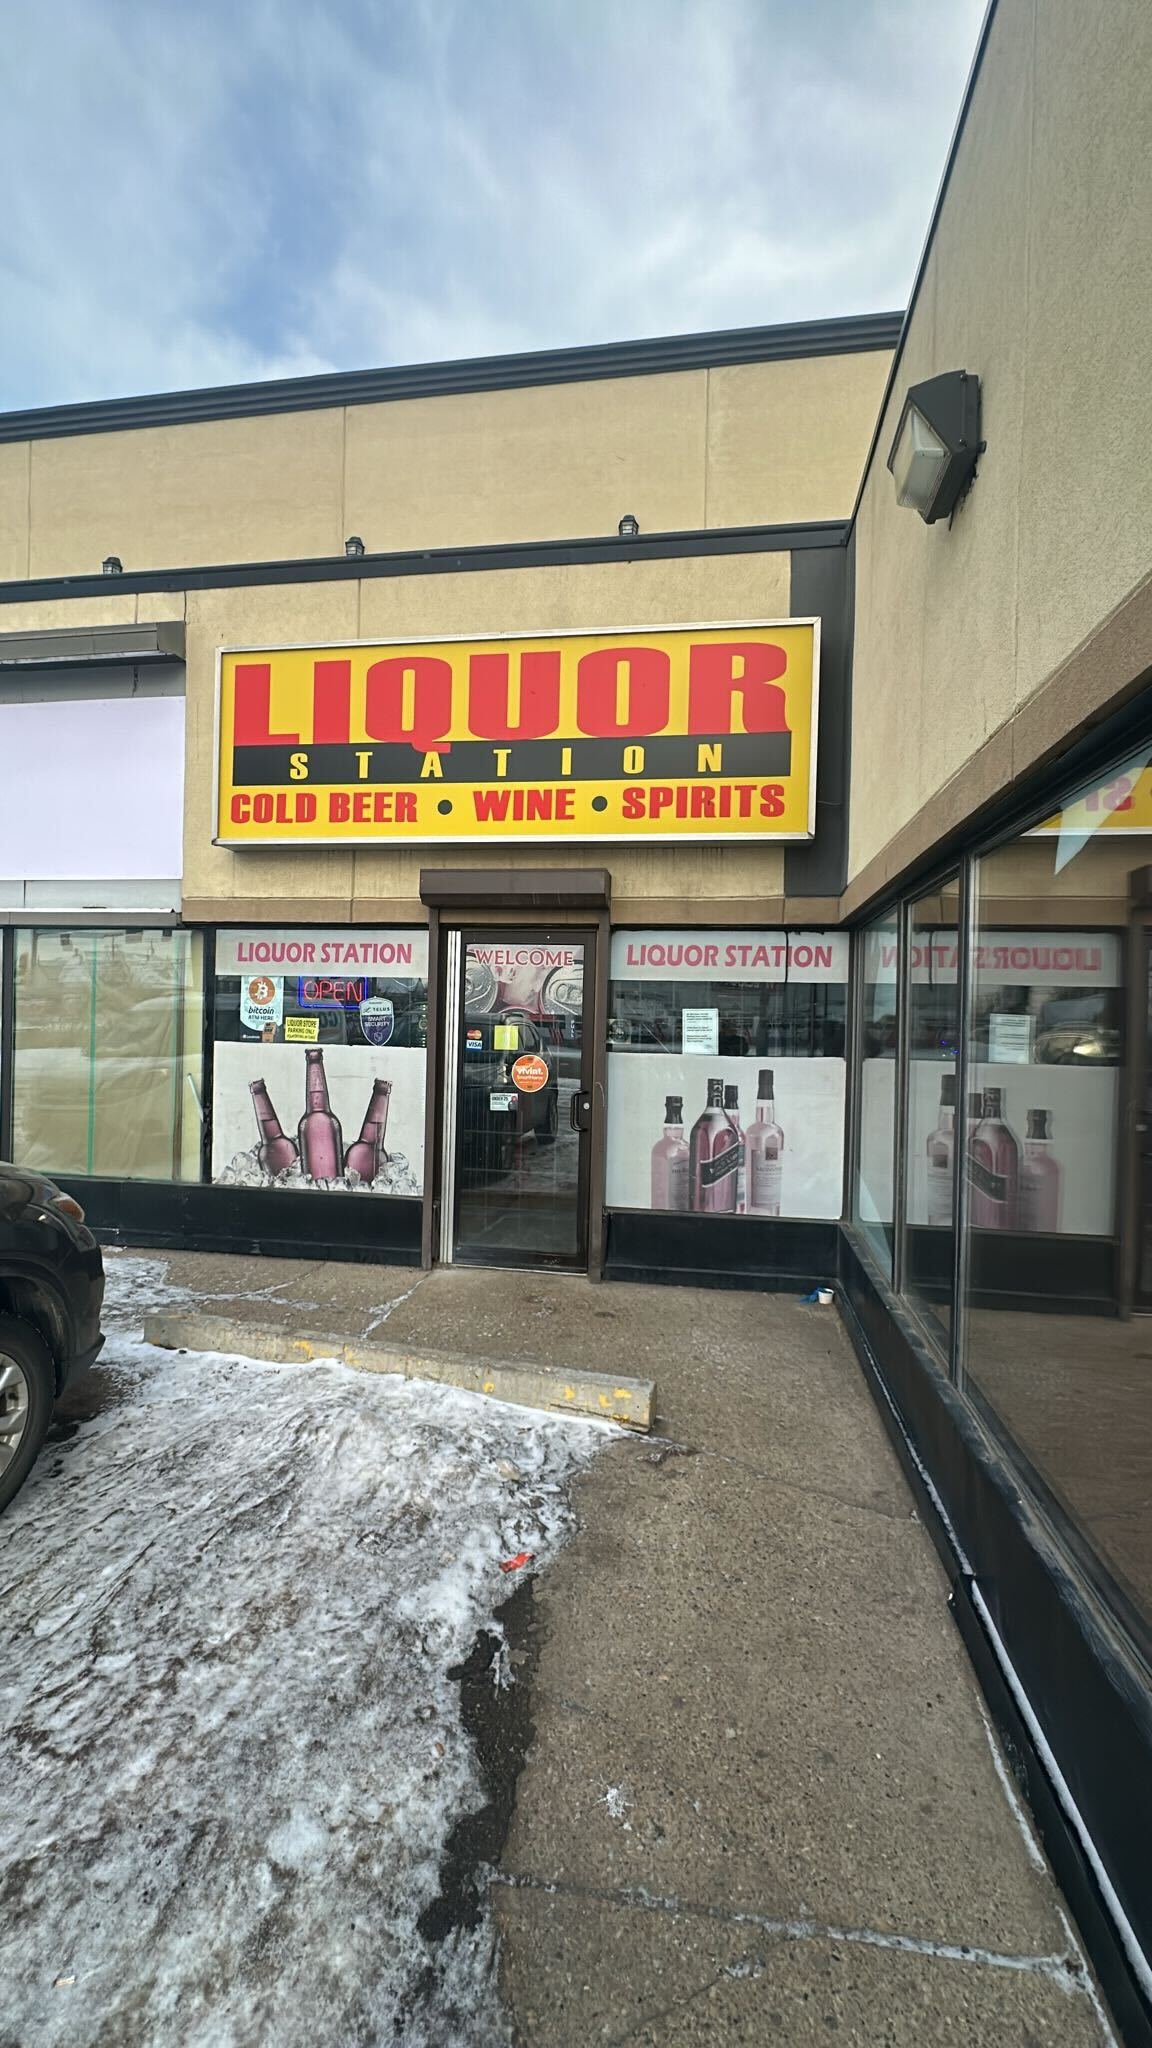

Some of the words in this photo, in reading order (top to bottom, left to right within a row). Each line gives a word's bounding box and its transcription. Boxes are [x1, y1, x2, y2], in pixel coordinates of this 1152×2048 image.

[233, 642, 792, 753] LIQUOR
[290, 743, 722, 779] STATION
[231, 793, 317, 823] COLD
[329, 792, 418, 823] BEER
[473, 789, 576, 822] WINE
[622, 784, 785, 819] SPIRITS
[237, 942, 316, 963] LIQUOR
[320, 943, 412, 964] STATION
[475, 949, 574, 966] WELCOME
[626, 944, 719, 966] LIQUOR
[724, 945, 833, 968] STATION
[303, 980, 363, 1002] OPEN
[248, 1005, 275, 1015] bitcoin
[286, 1019, 302, 1027] LIQUOR
